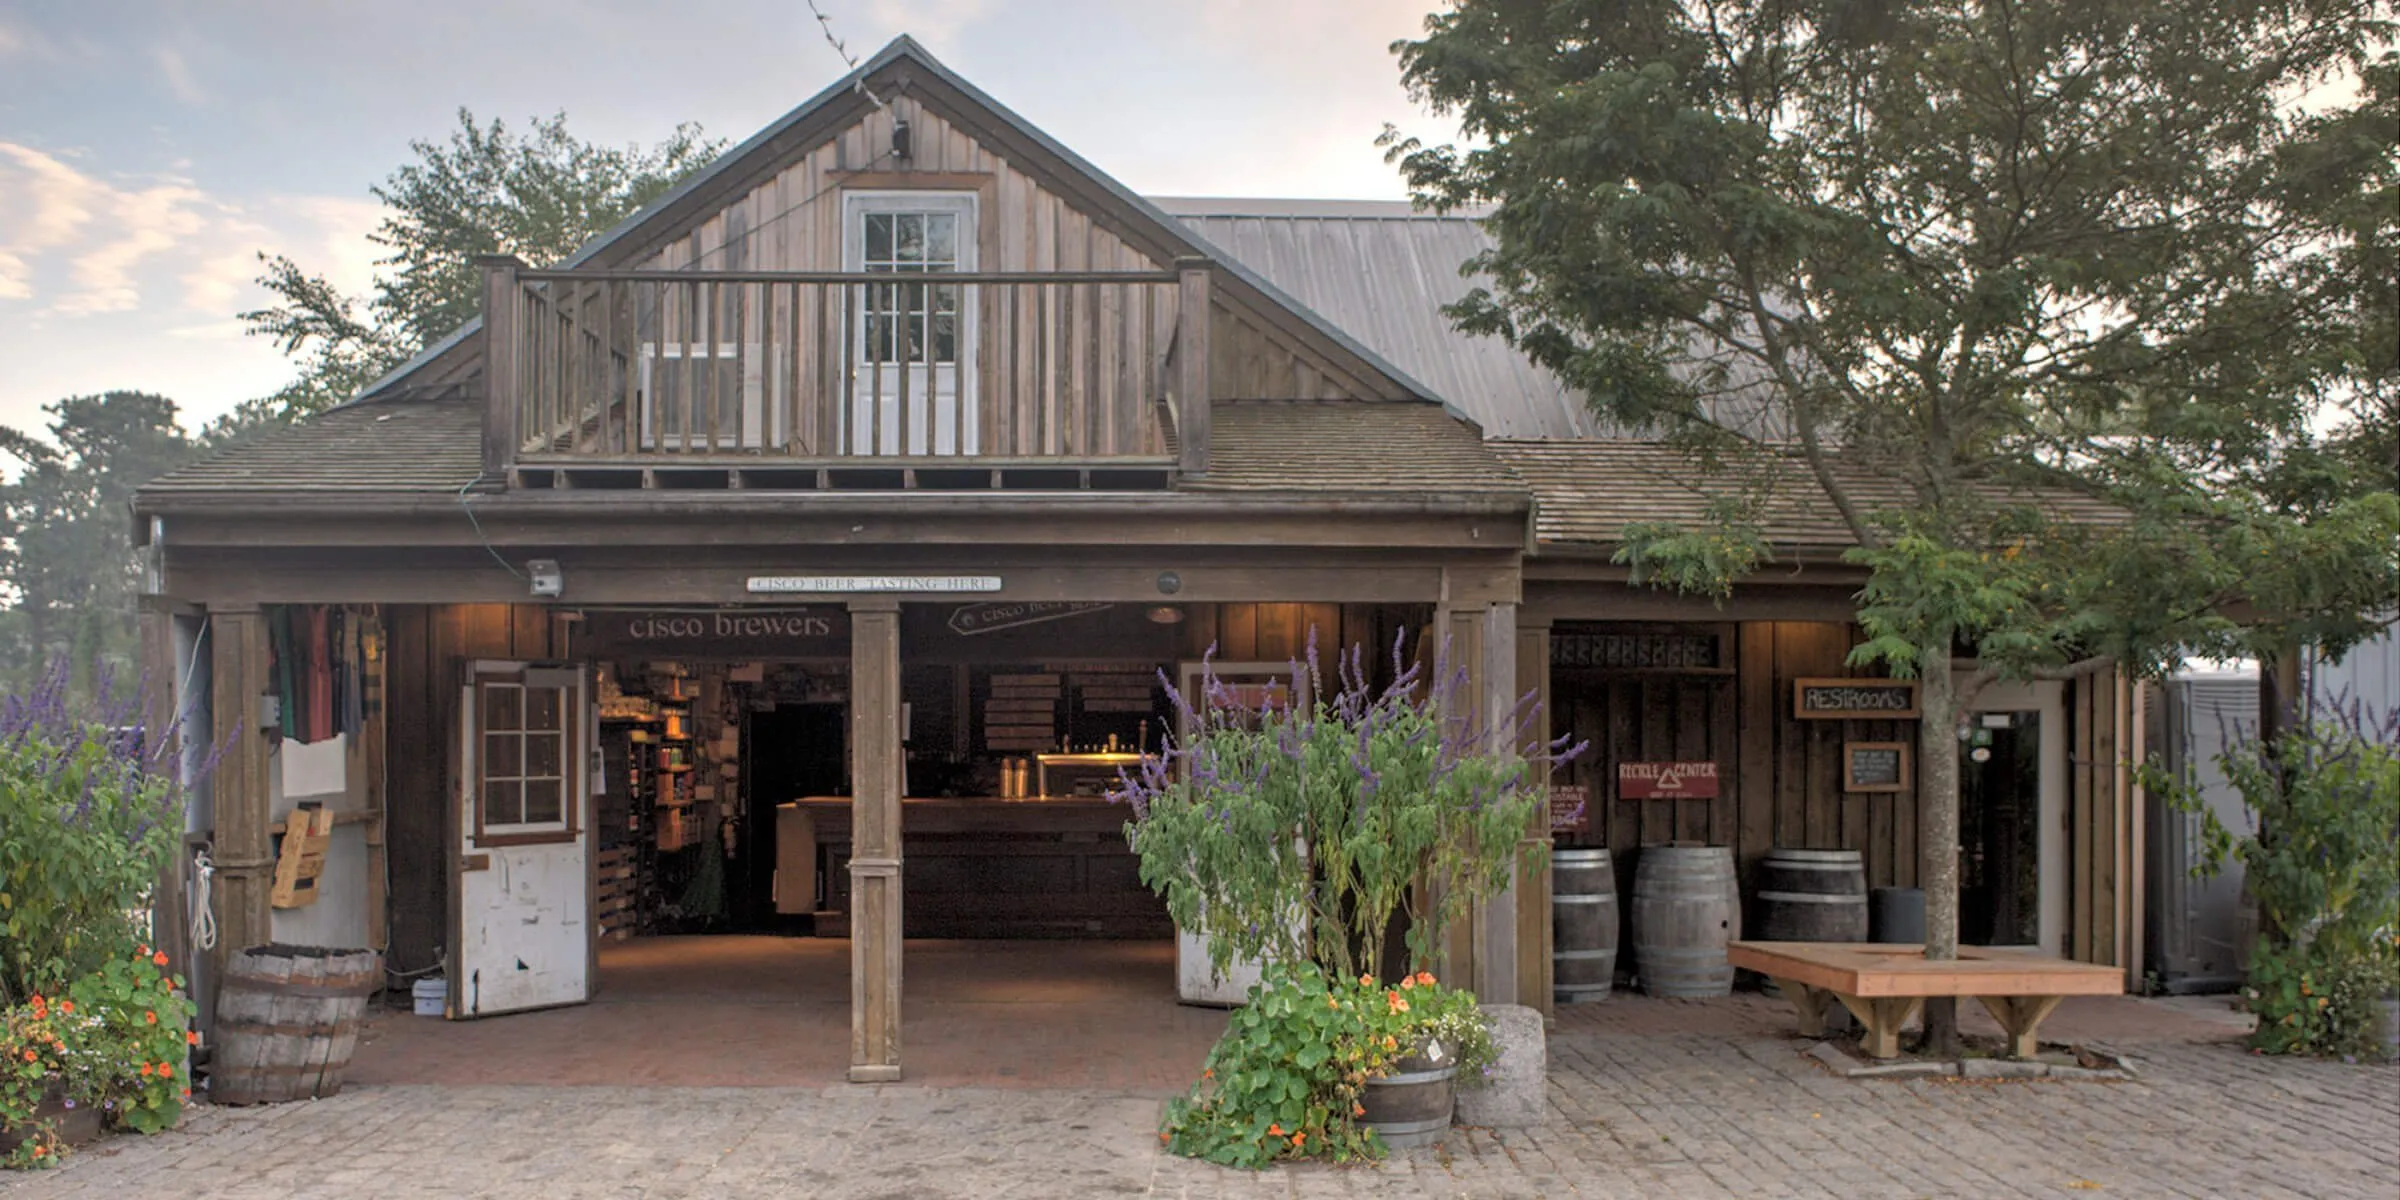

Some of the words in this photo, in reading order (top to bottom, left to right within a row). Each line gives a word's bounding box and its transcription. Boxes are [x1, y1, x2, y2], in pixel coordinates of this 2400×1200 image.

[751, 578, 805, 590] CISCO
[814, 578, 856, 590] BEER
[866, 577, 937, 590] TASTING
[947, 577, 991, 590] HERE
[629, 613, 705, 638] cisco
[715, 611, 831, 637] brewers
[1805, 687, 1907, 710] RESTROOMS
[1673, 762, 1717, 777] CENTER
